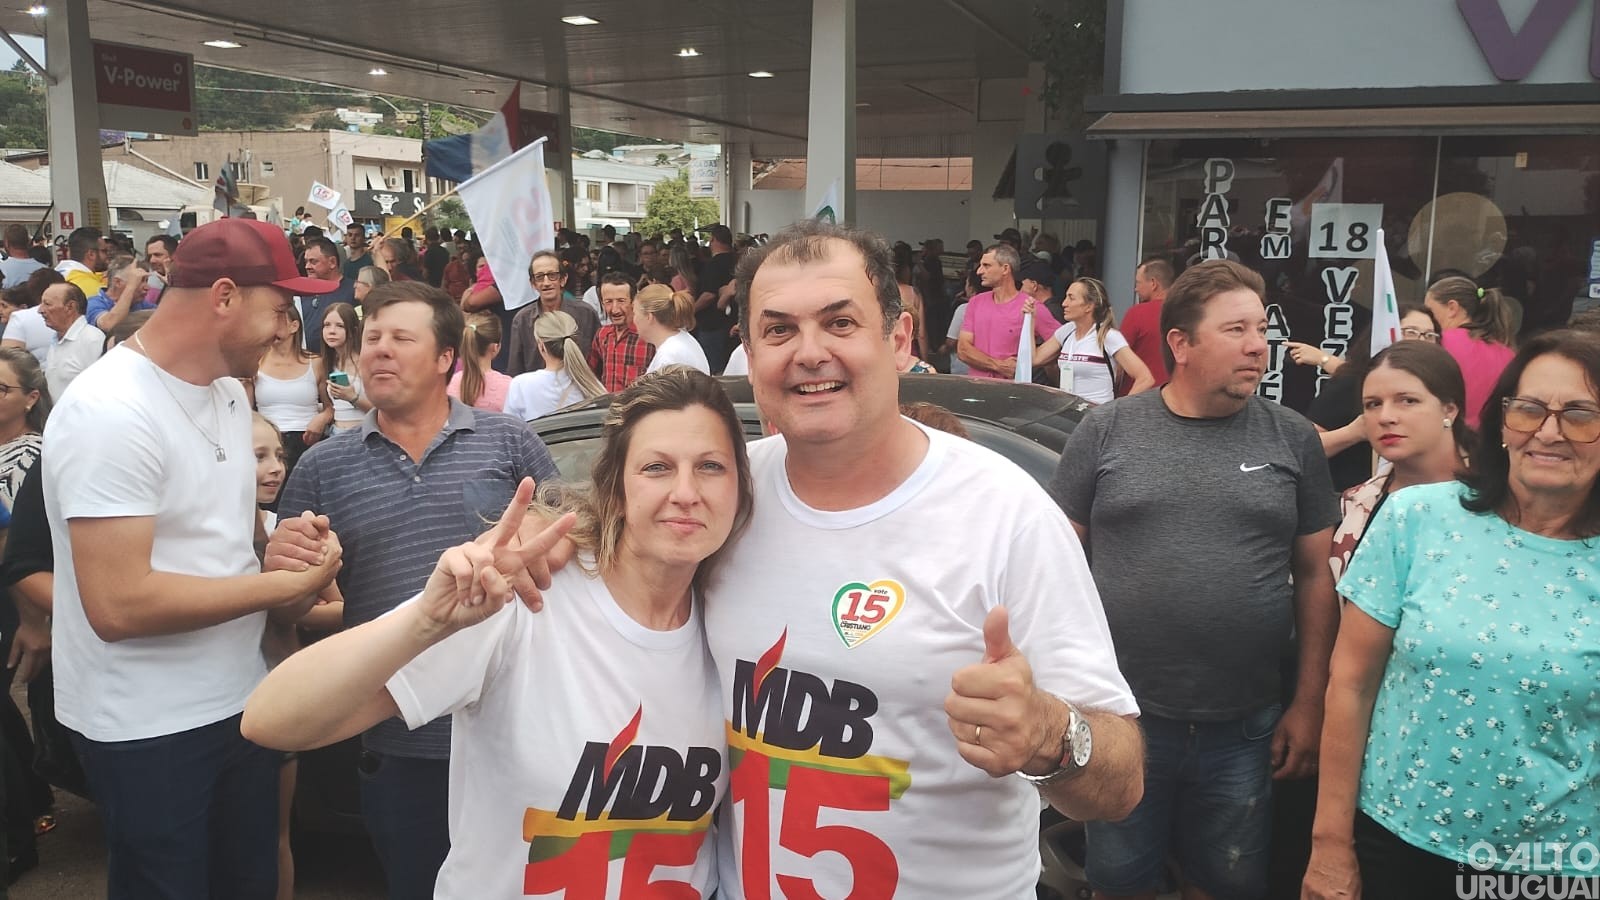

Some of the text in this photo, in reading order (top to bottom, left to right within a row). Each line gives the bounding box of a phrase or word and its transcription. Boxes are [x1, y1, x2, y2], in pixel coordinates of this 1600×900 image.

[103, 65, 180, 92] V-Power
[1264, 200, 1291, 257] EM
[1318, 222, 1369, 252] 18
[841, 592, 890, 623] 15
[732, 658, 878, 759] MDB
[556, 740, 721, 821] MDB
[729, 748, 899, 900] 15
